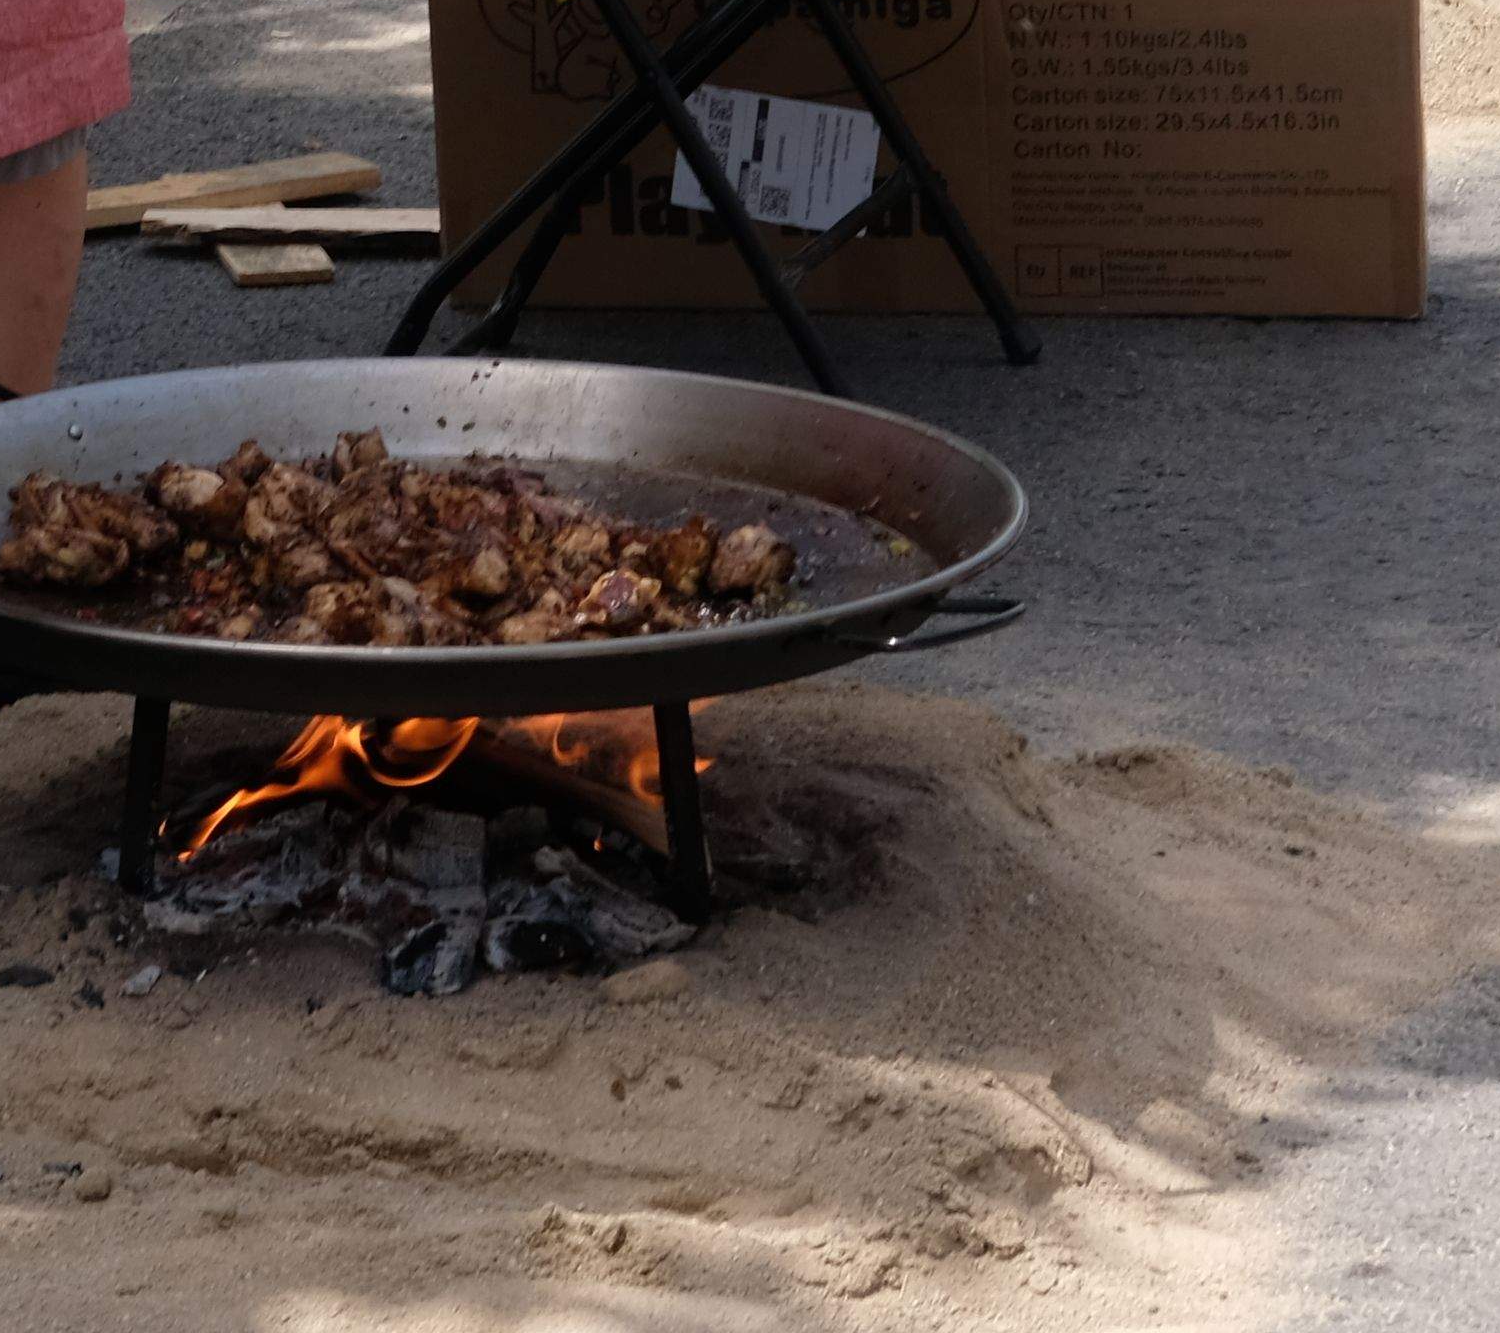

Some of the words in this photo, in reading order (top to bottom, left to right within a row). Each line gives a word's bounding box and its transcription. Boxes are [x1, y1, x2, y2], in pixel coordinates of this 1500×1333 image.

[1124, 3, 1136, 21] 1
[1011, 84, 1089, 106] Carton
[1094, 84, 1148, 106] size:
[1013, 112, 1090, 133] Carton
[1095, 112, 1149, 133] size:
[1013, 139, 1090, 161] Carton
[1103, 140, 1144, 160] No:
